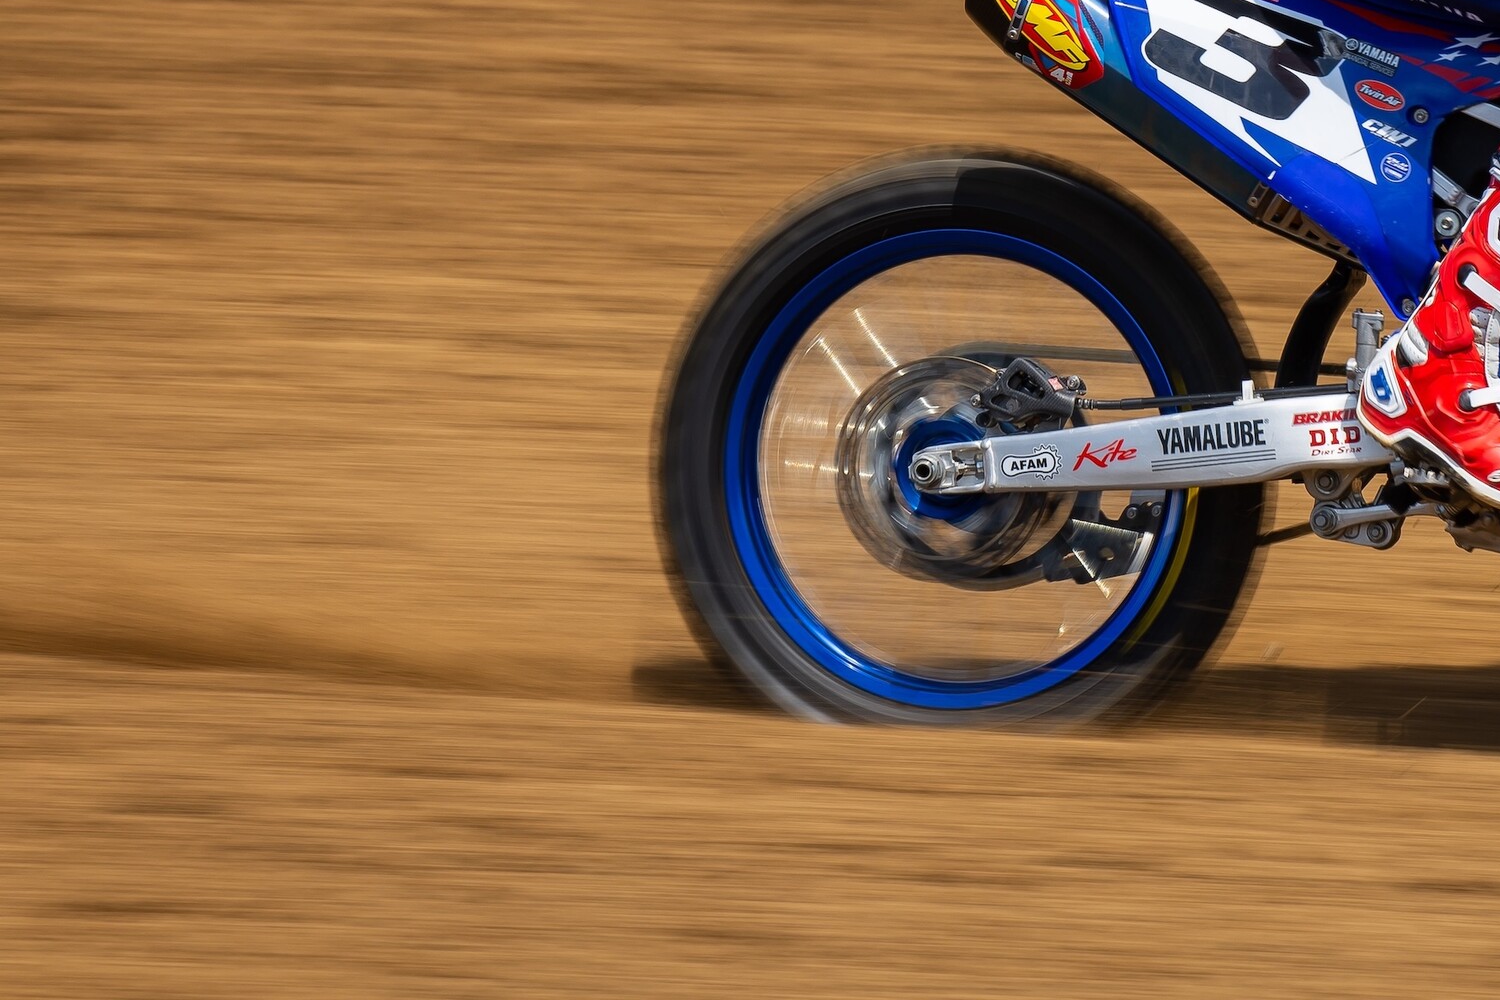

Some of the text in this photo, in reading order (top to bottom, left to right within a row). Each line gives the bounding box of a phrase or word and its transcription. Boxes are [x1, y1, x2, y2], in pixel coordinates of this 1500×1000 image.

[1358, 42, 1400, 68] YAMAHA
[1360, 84, 1402, 106] Twin Air
[1292, 408, 1357, 425] BRAKIN
[1157, 419, 1267, 455] YAMALUBE
[1010, 458, 1048, 472] AFAM
[1072, 439, 1138, 472] Kite
